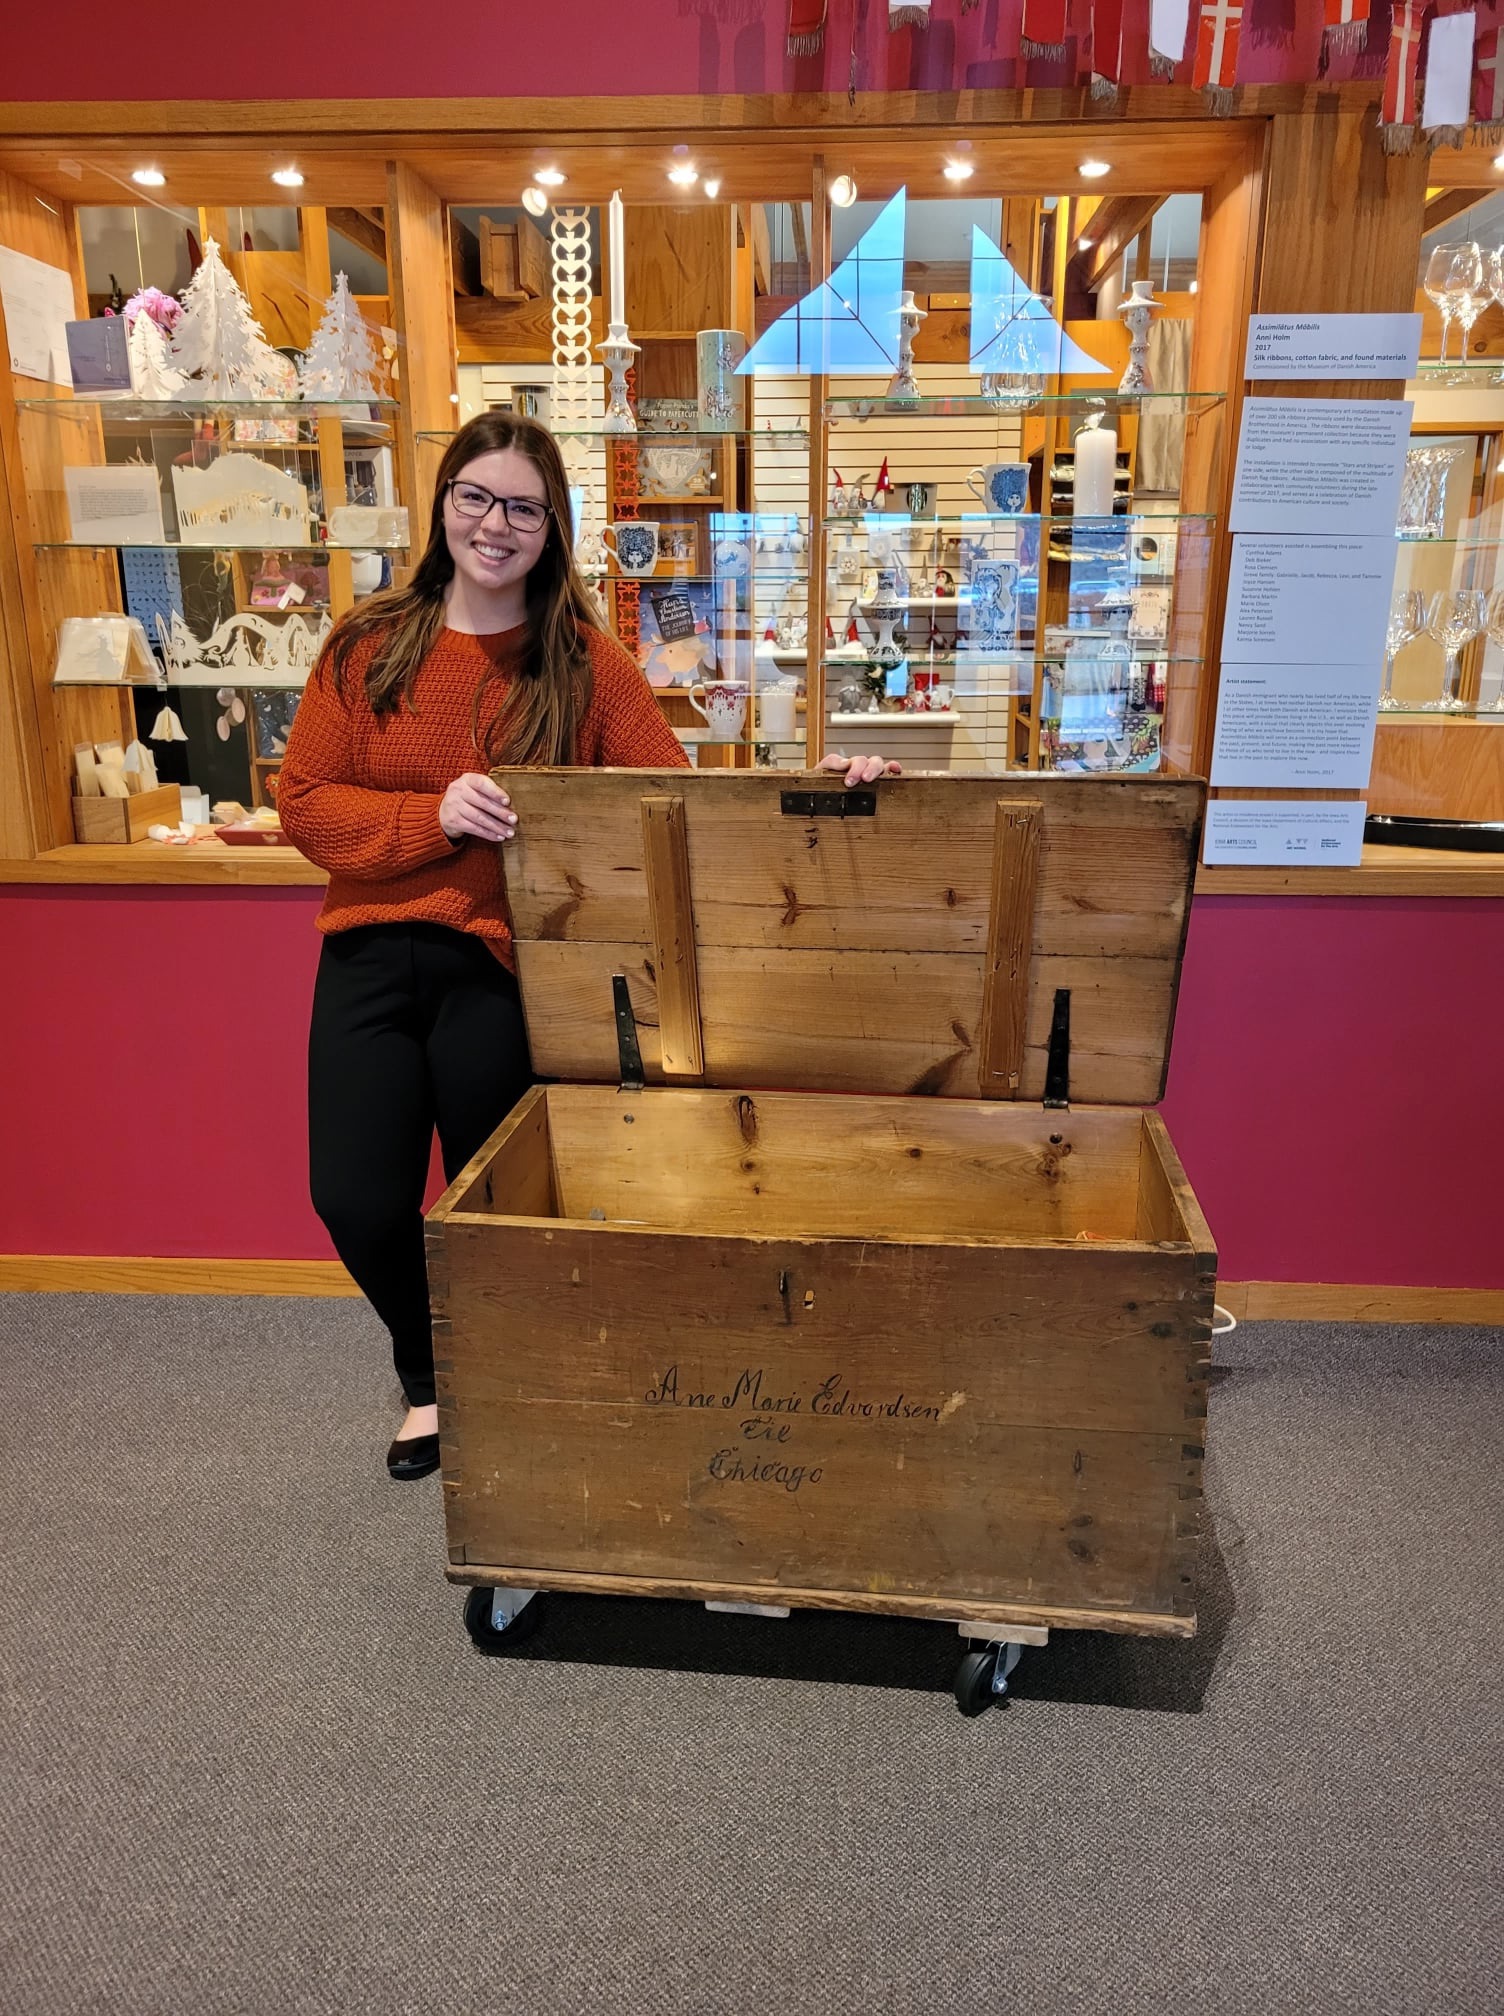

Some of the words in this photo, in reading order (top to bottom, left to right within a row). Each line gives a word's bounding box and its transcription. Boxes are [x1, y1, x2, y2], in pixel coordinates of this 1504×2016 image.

[1266, 354, 1294, 362] ribbons,
[1318, 354, 1339, 362] fabric,
[645, 1364, 715, 1407] Ane
[721, 1368, 803, 1413] Marie
[708, 1447, 824, 1492] Chicago
